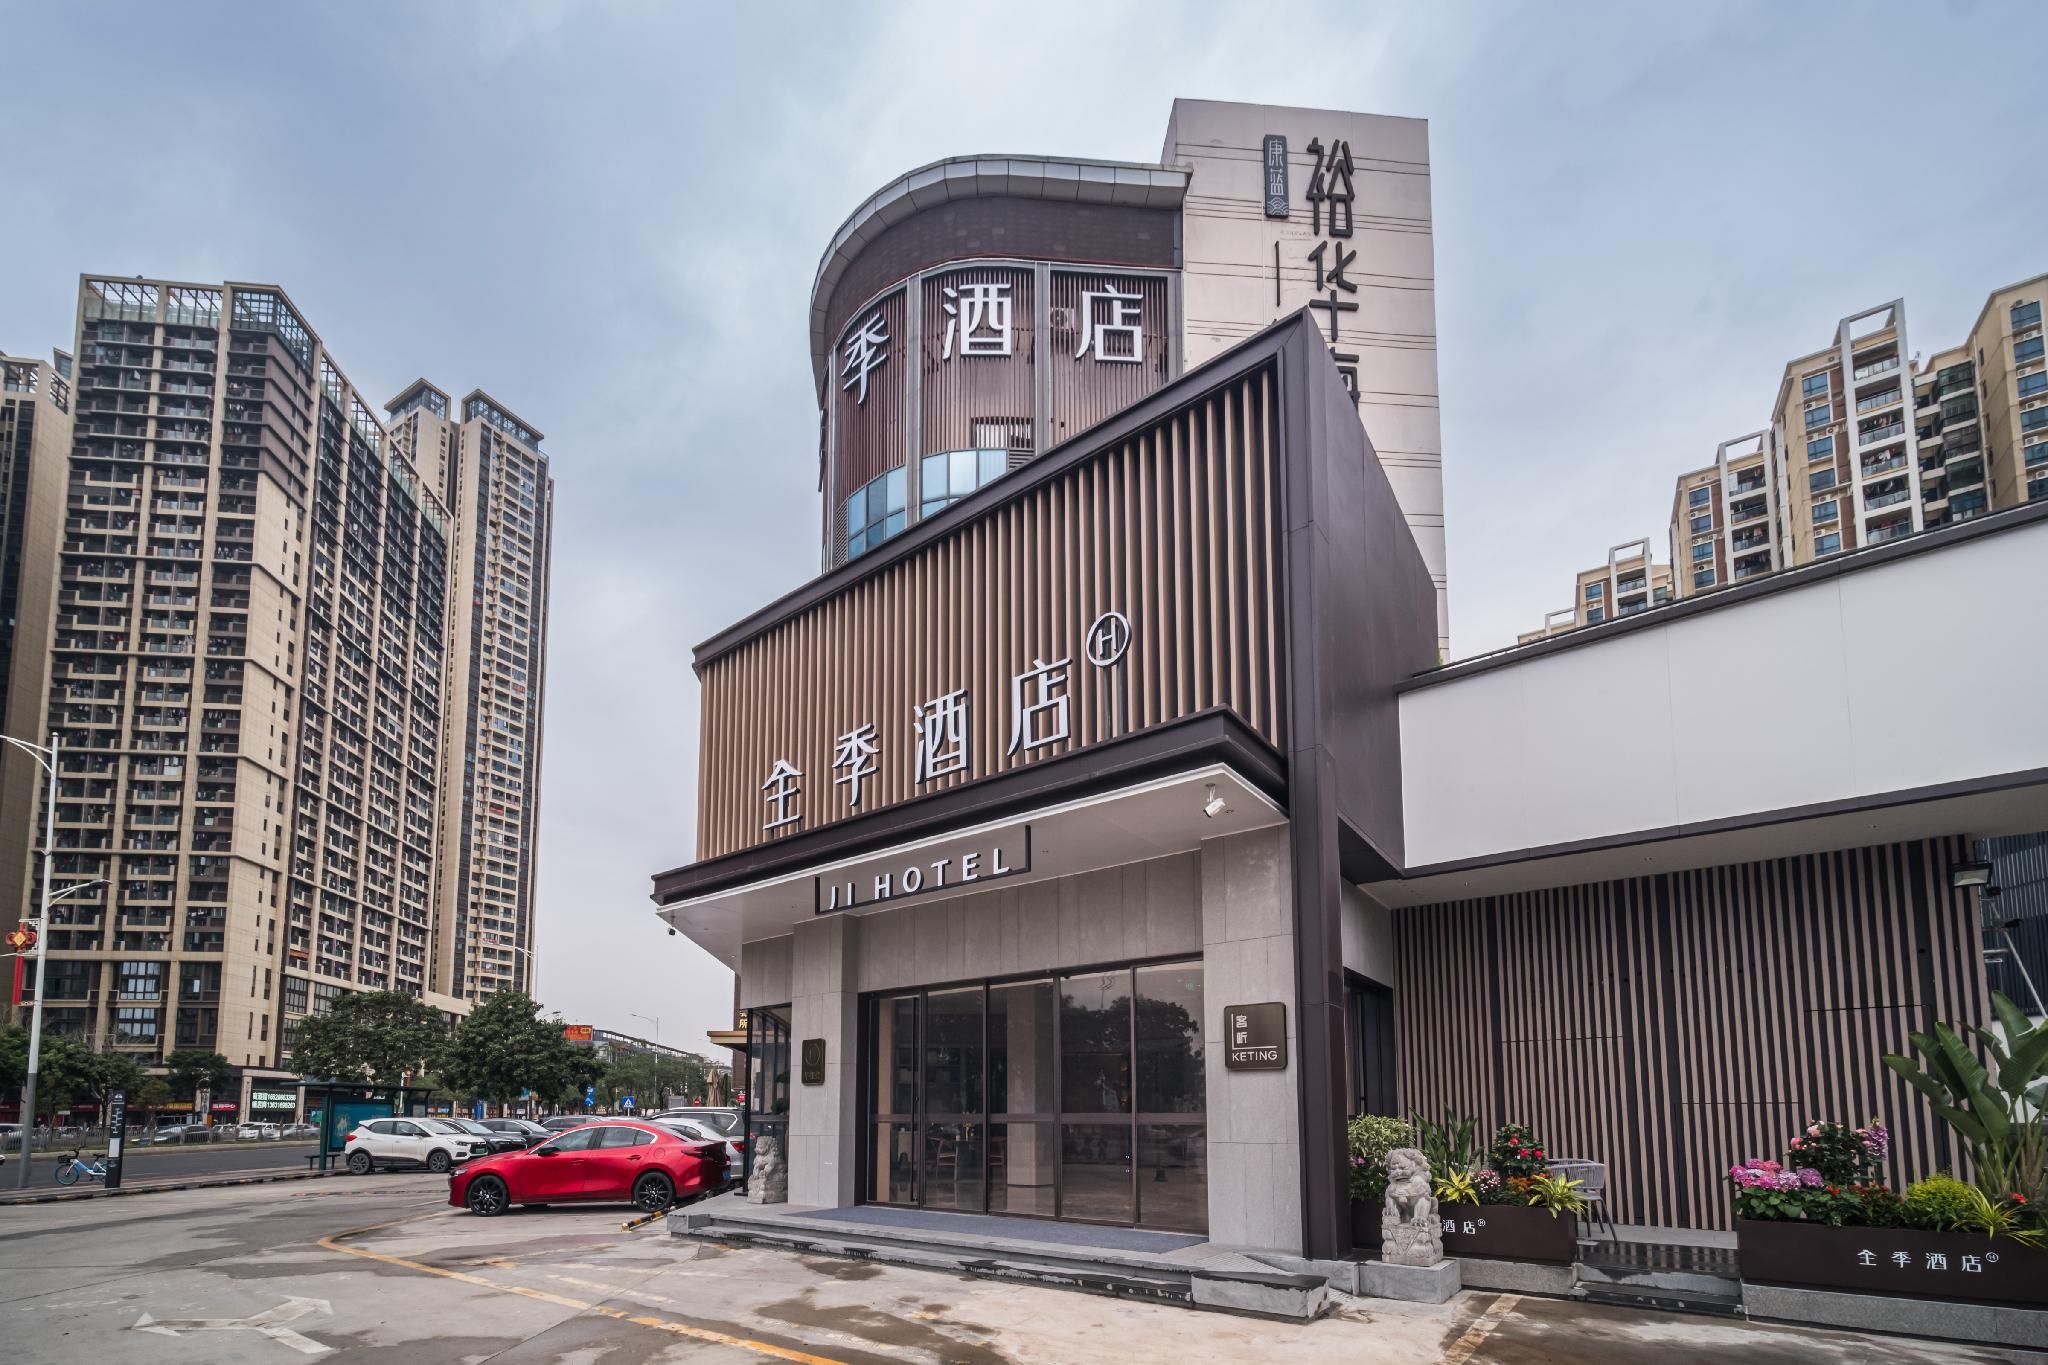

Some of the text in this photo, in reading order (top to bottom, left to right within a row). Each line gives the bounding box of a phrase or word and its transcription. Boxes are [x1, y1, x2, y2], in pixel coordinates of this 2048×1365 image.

[762, 657, 1072, 831] 全季酒店
[828, 847, 1013, 910] JI HOTEL
[1232, 1050, 1278, 1062] KETING
[1442, 1219, 1476, 1235] 酒店
[1857, 1249, 1982, 1273] 全季酒店
